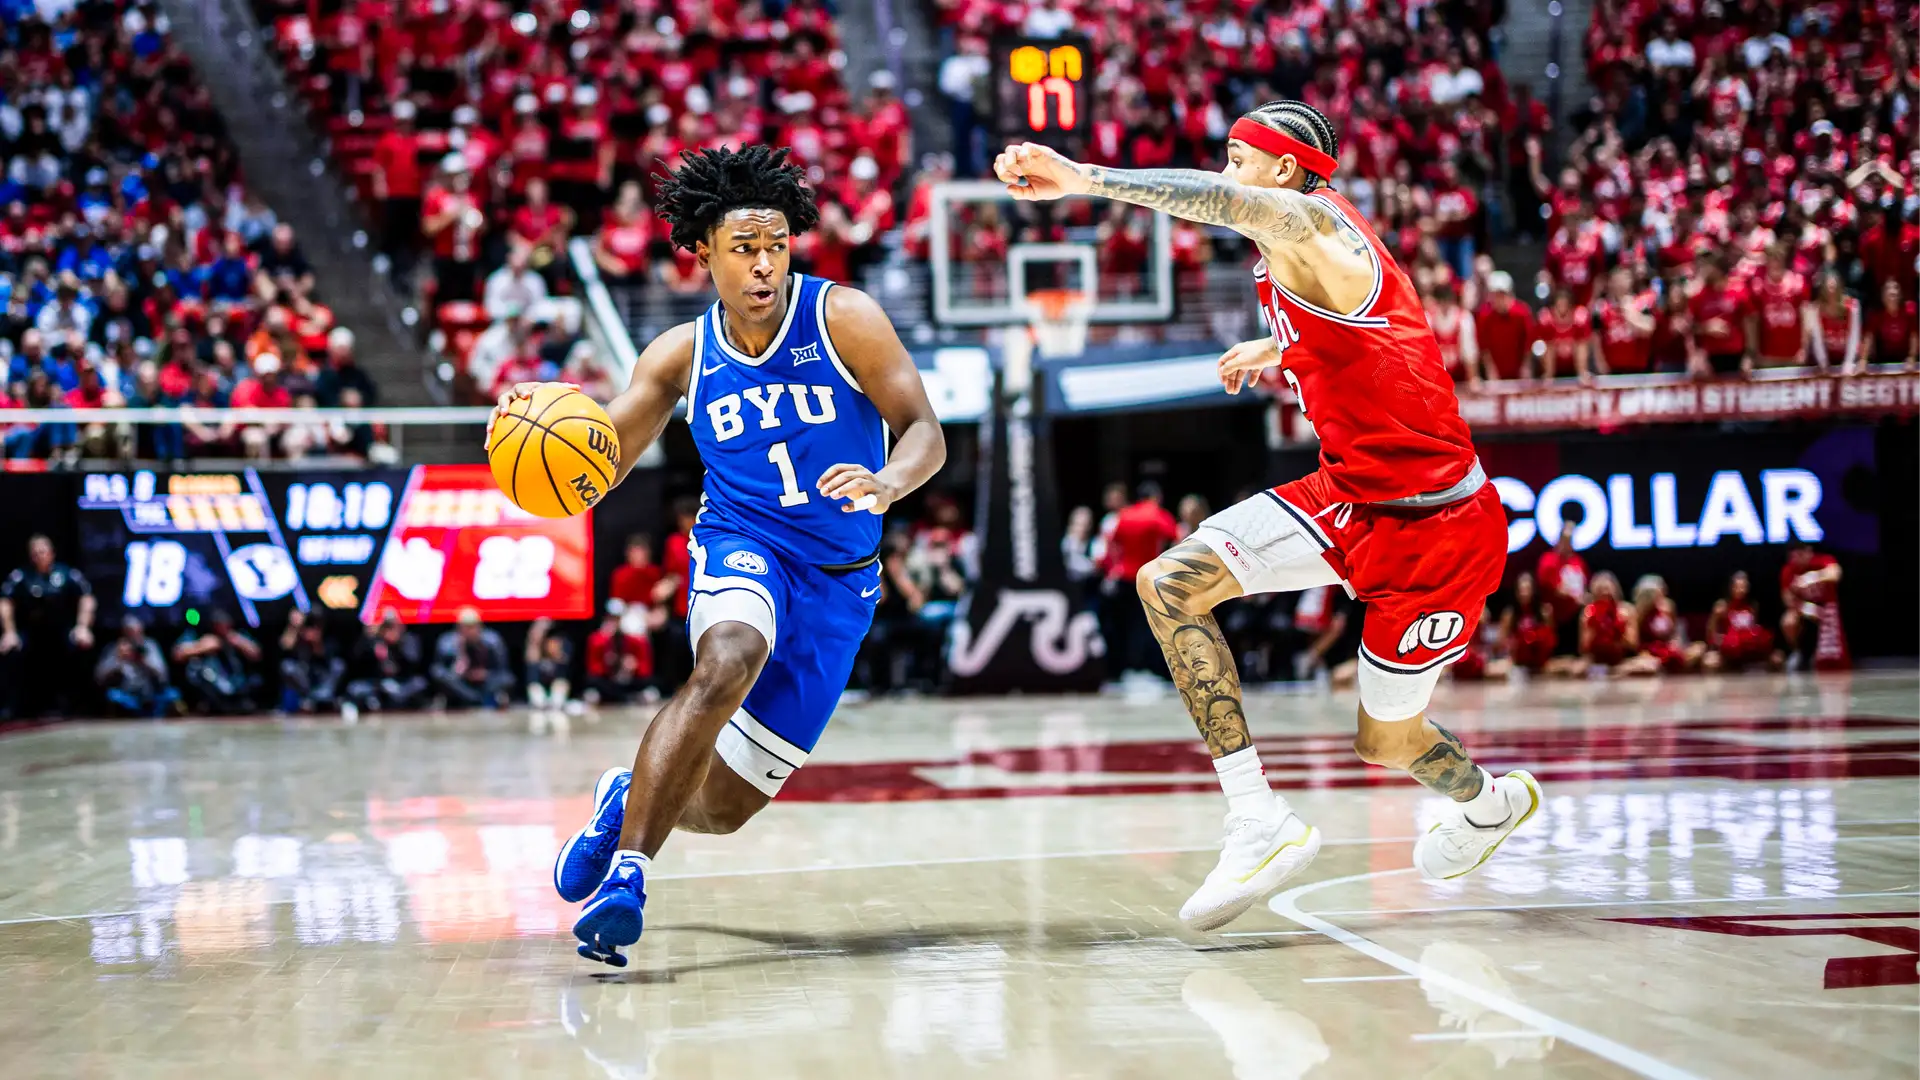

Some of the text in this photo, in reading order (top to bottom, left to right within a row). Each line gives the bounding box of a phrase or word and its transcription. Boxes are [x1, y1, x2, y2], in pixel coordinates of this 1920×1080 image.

[1028, 76, 1076, 132] 17
[706, 383, 837, 443] BYU
[1702, 379, 1832, 415] STUDENT
[767, 441, 809, 508] 1
[1492, 468, 1824, 554] COLLAR
[123, 540, 188, 607] 18
[1427, 617, 1458, 643] U
